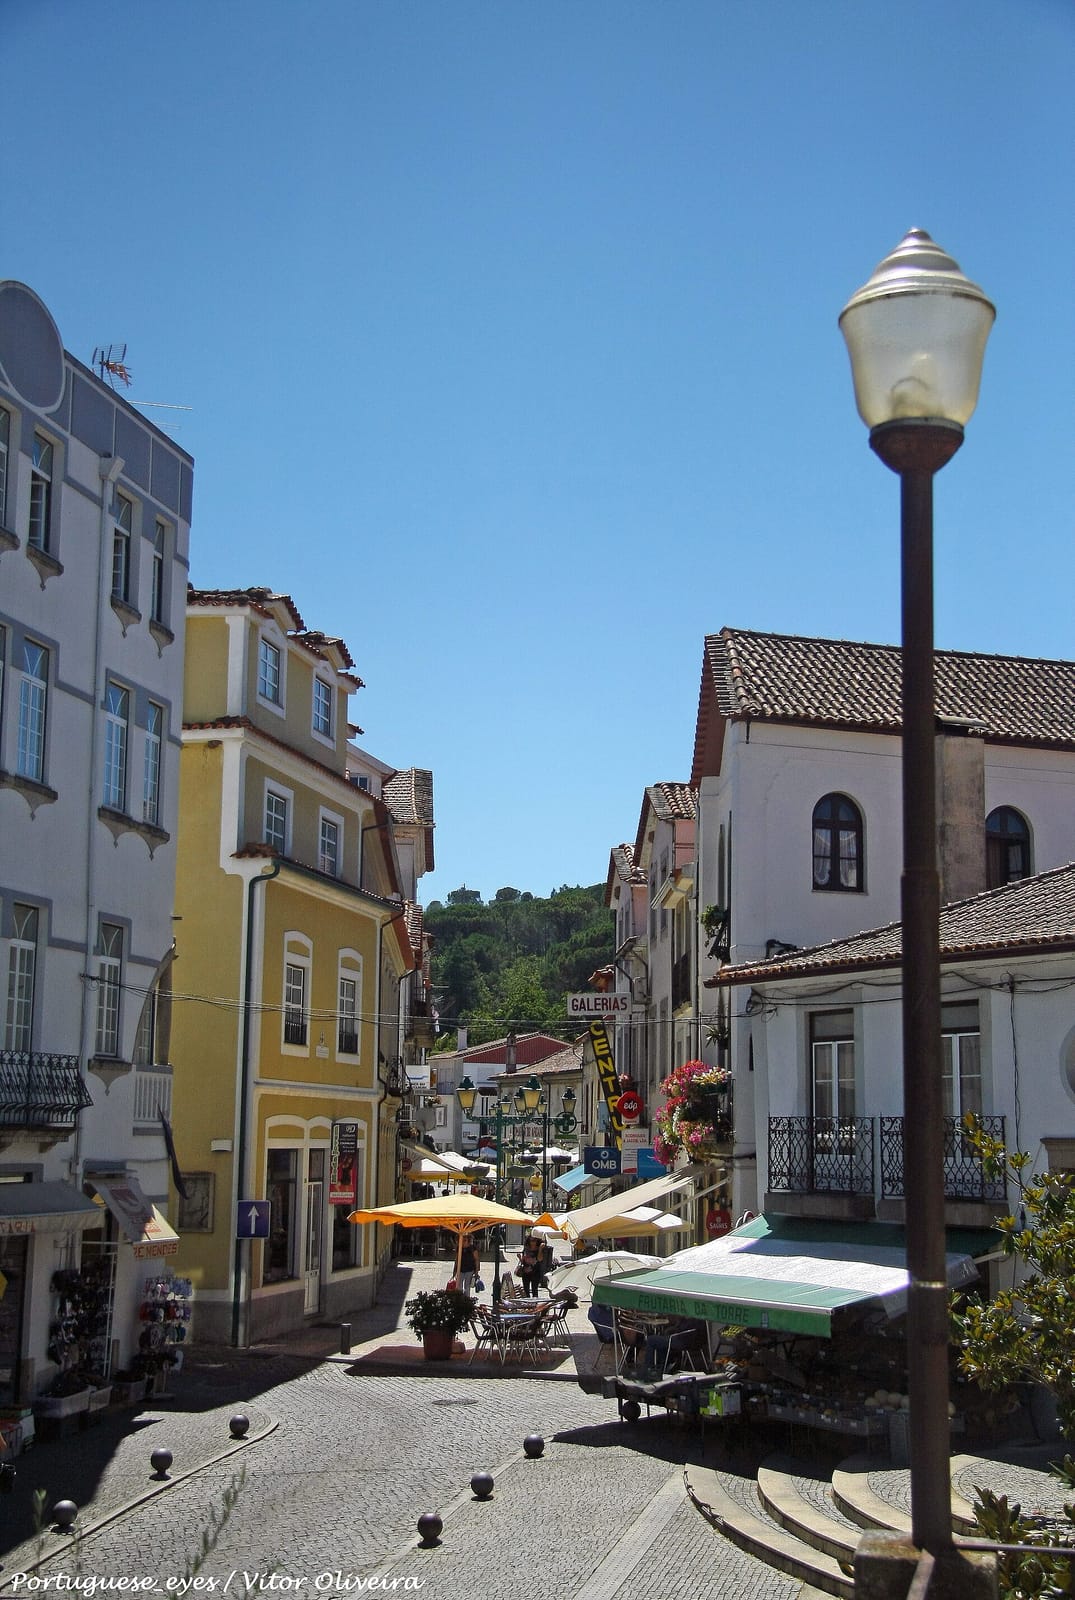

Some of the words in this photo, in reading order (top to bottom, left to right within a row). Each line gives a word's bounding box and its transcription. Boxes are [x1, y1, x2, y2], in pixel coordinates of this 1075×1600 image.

[572, 997, 627, 1011] GALERIAS
[623, 1100, 638, 1111] edp
[591, 1159, 617, 1169] OMB
[146, 1242, 177, 1257] MENDES
[638, 1294, 687, 1314] FRUTARIA
[694, 1301, 708, 1316] DA
[716, 1304, 749, 1322] TORRE
